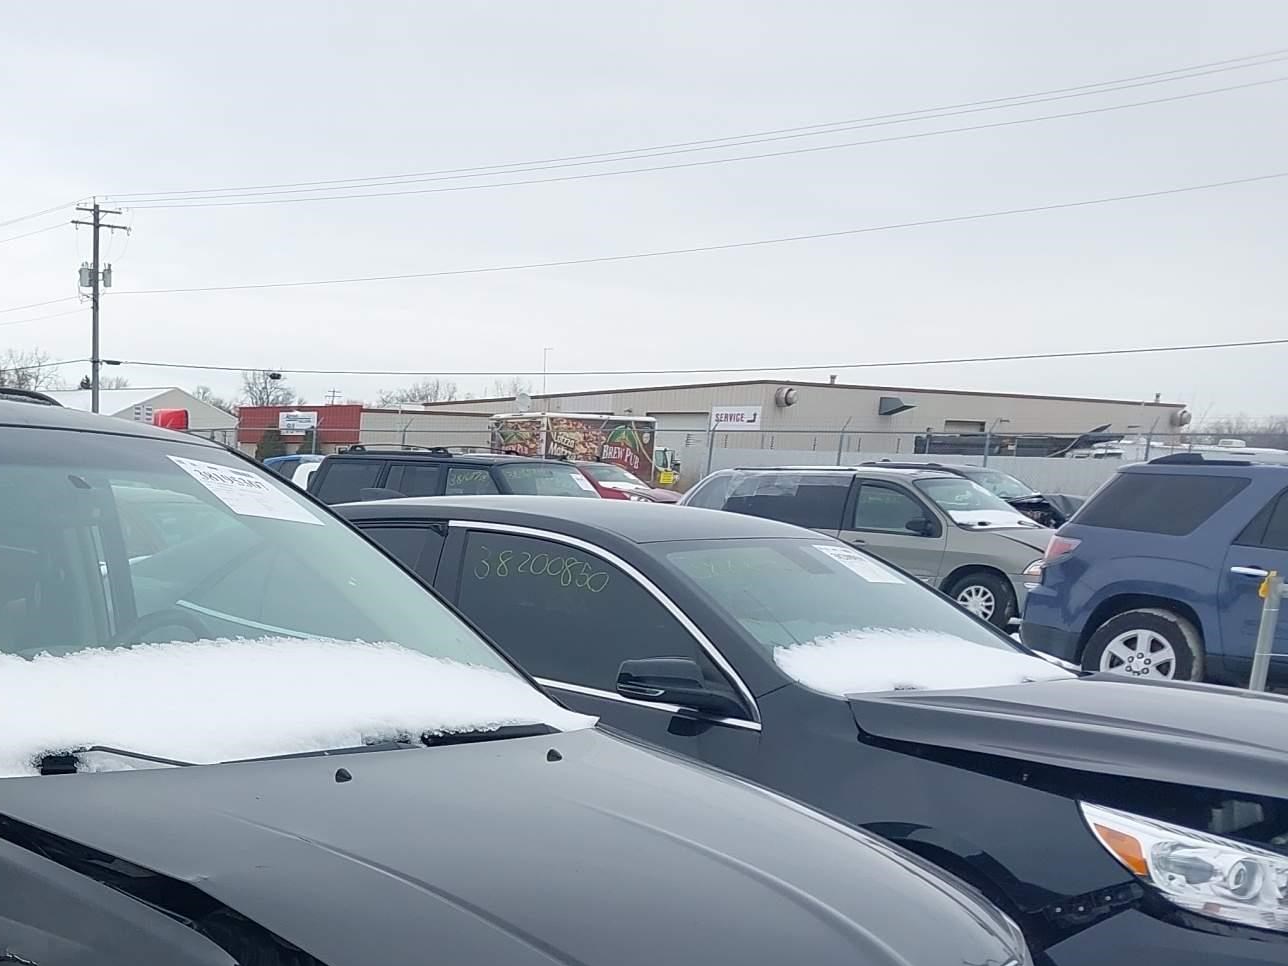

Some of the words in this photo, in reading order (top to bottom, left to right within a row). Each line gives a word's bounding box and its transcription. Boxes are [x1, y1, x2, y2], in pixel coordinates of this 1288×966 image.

[714, 412, 744, 423] SERVICE
[601, 444, 625, 460] BREW
[624, 447, 640, 469] PUB
[474, 545, 609, 593] 38200850
